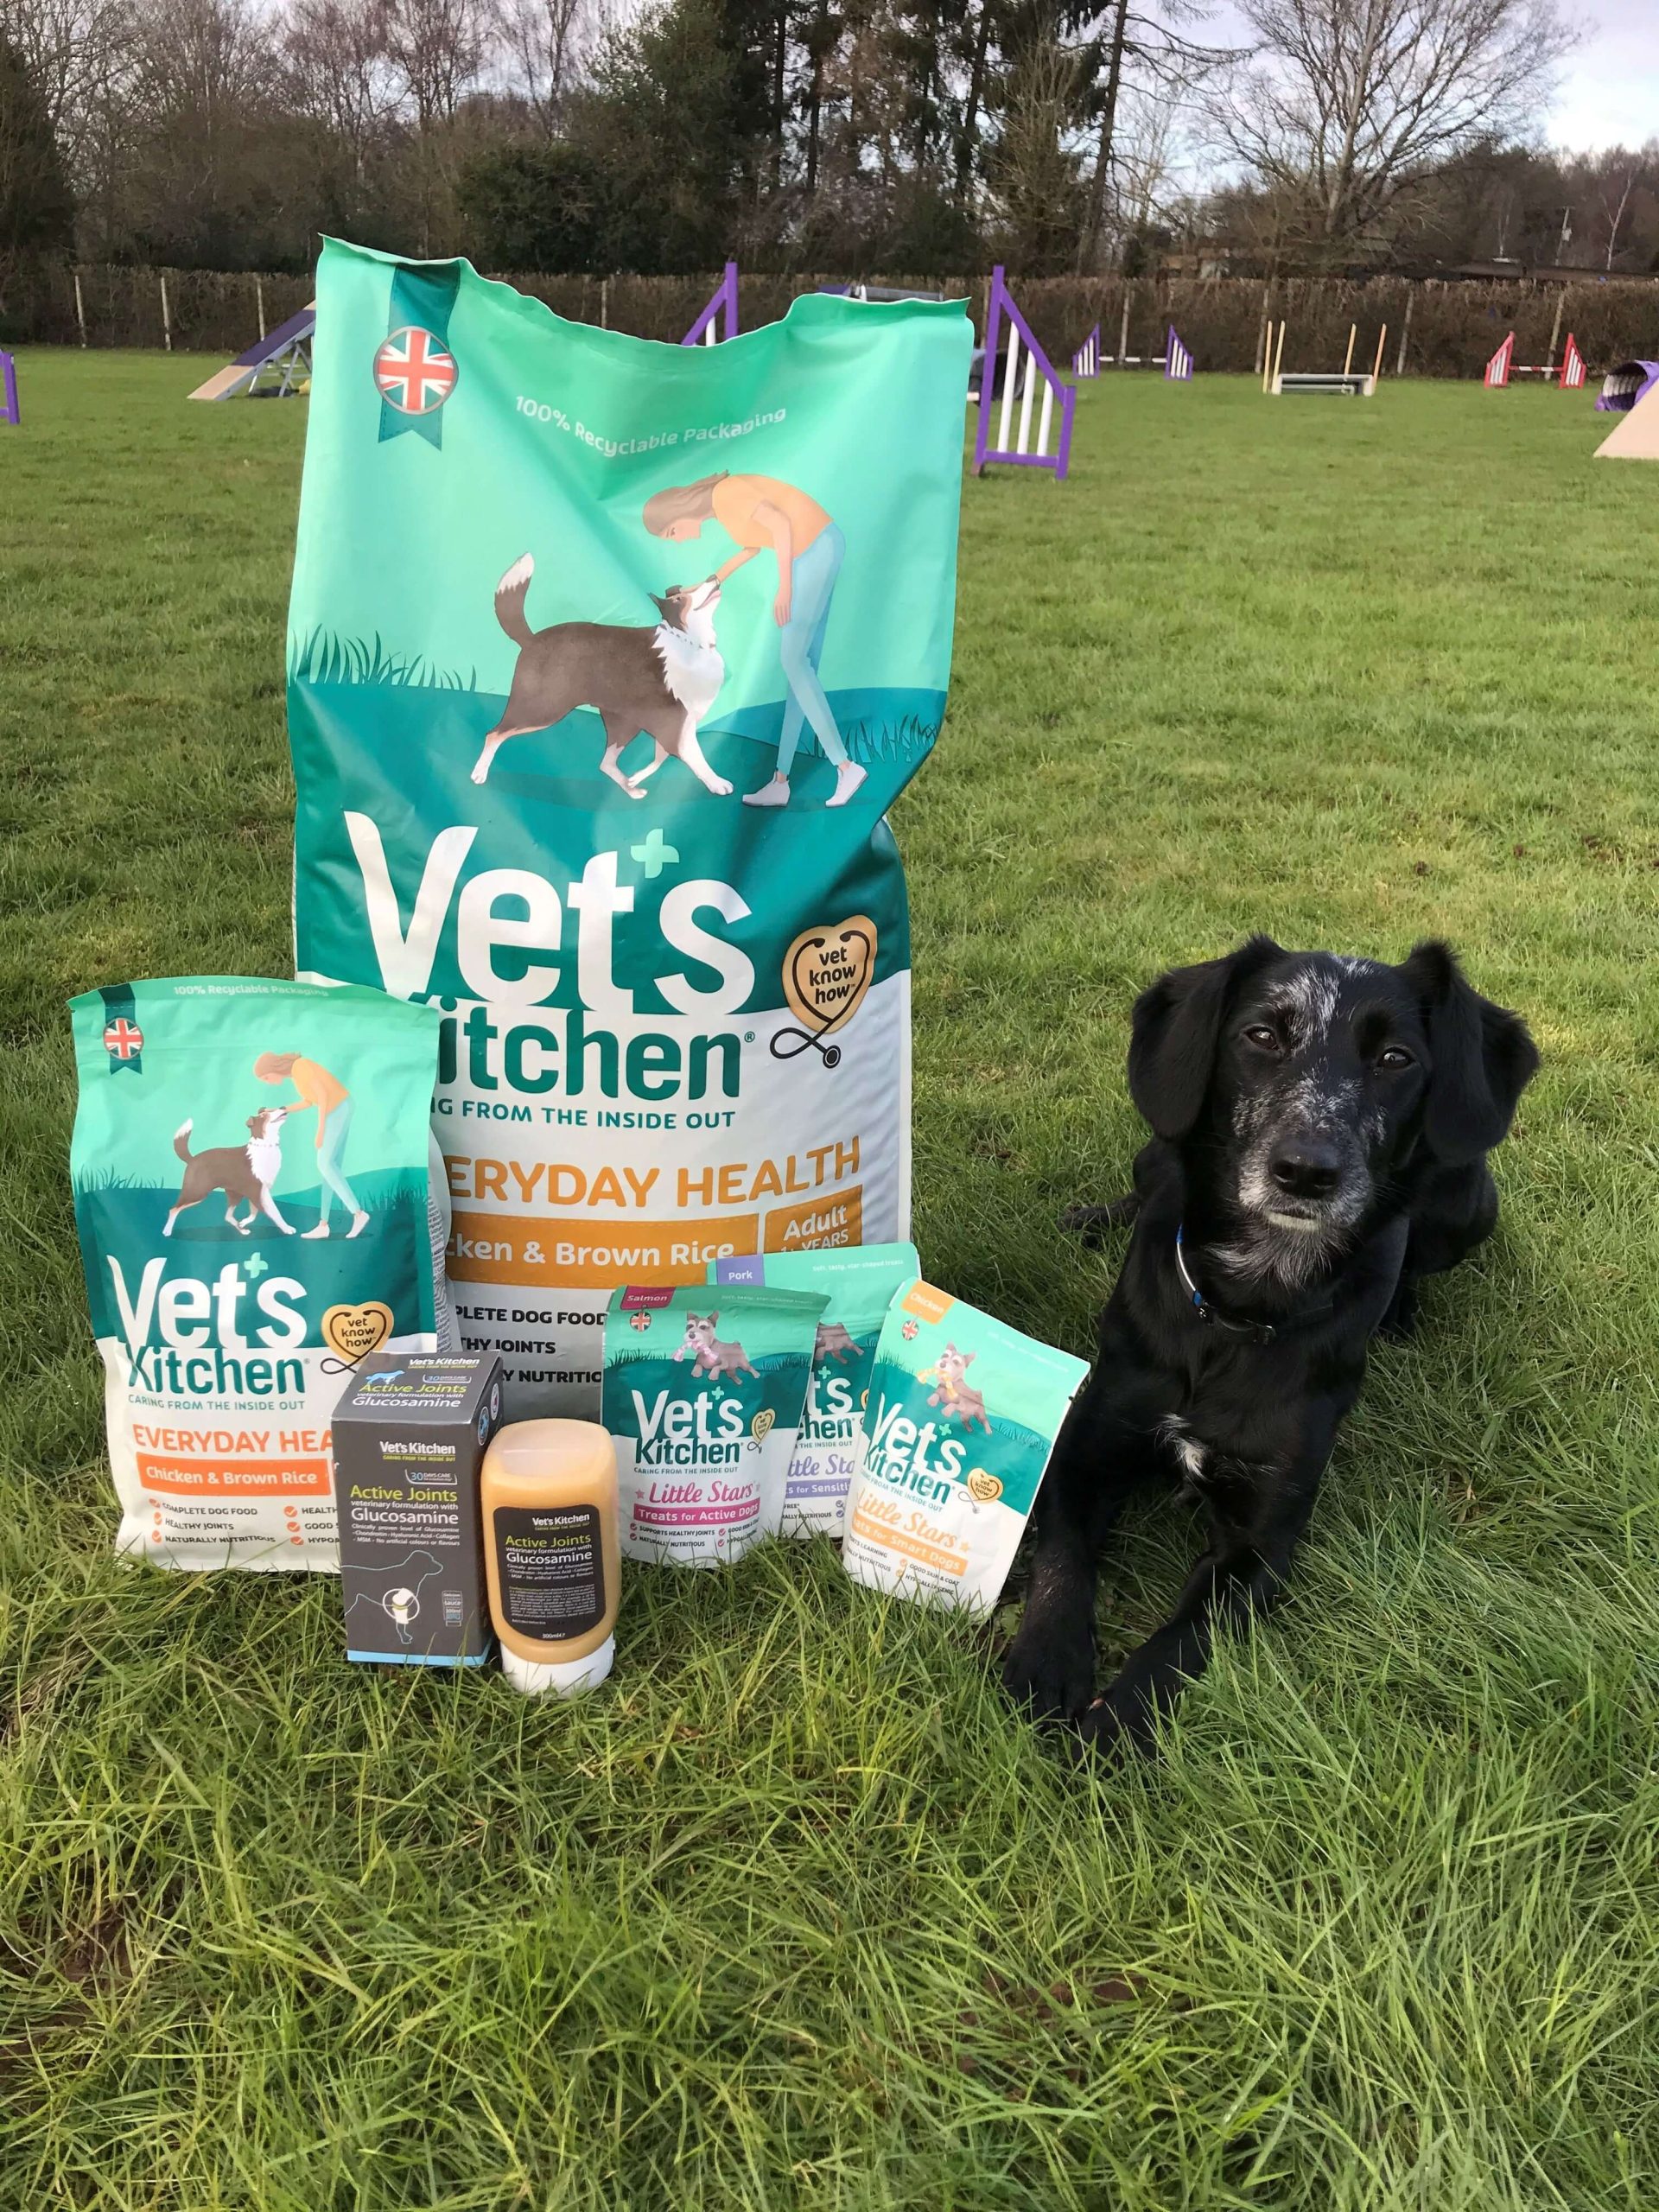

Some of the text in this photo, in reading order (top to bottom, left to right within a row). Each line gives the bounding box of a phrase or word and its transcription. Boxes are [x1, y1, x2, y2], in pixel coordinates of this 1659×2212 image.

[516, 396, 786, 457] 100% Recyclable Packaging
[819, 946, 848, 966] vet
[810, 964, 856, 987] know
[175, 984, 329, 996] 100% Recyclable Packaging
[462, 1100, 532, 1122] FROM
[541, 1107, 588, 1126] THE
[597, 1110, 677, 1129] INSIDE
[686, 1111, 735, 1128] OUT
[444, 1135, 861, 1208] ERYDAY HEALTH
[784, 1205, 848, 1241] Adult
[523, 1243, 545, 1264] &
[556, 1242, 660, 1267] Brown
[671, 1240, 734, 1266] Rice
[728, 1270, 753, 1281] Pork
[910, 1292, 944, 1313] Chicken
[347, 1318, 367, 1327] vet
[455, 1305, 607, 1325] PLETE DOG FOOD
[341, 1327, 375, 1337] know
[496, 1339, 556, 1354] JOINTS
[519, 1370, 601, 1383] NUTRITIO
[416, 1384, 467, 1393] Joints
[806, 1369, 853, 1414] t's
[129, 1395, 305, 1410] CARING FROM THE INSIDE OUT
[353, 1397, 461, 1408] Glucosamine
[132, 1423, 333, 1452] EVERYDAY HEA
[380, 1440, 455, 1454] Vet's Kitchen
[787, 1455, 820, 1477] ttle
[825, 1453, 855, 1475] Sta
[146, 1466, 317, 1484] Chicken & Brown Rice
[410, 1472, 423, 1481] 30
[350, 1484, 458, 1502] Active Joints
[649, 1480, 753, 1503] Little Stars
[811, 1482, 848, 1493] Sensiti
[871, 1478, 944, 1513] FROM THE INSIDE OUT
[162, 1503, 206, 1515] COMPLETE
[351, 1500, 391, 1510] veterinary
[391, 1501, 438, 1510] formulation
[638, 1509, 677, 1522] Treats
[699, 1510, 736, 1521] Active
[739, 1503, 759, 1517] Dogs
[165, 1518, 200, 1529] HEALTHY
[351, 1508, 459, 1524] Glucosamine
[532, 1516, 553, 1526] Vet's
[555, 1514, 590, 1525] Kitchen
[857, 1487, 957, 1548] Little Stars
[639, 1525, 667, 1535] SUPPORTS
[505, 1535, 591, 1548] Active Joints
[855, 1519, 961, 1570] ats for Smart Dogs
[506, 1551, 593, 1564] Glucosamine
